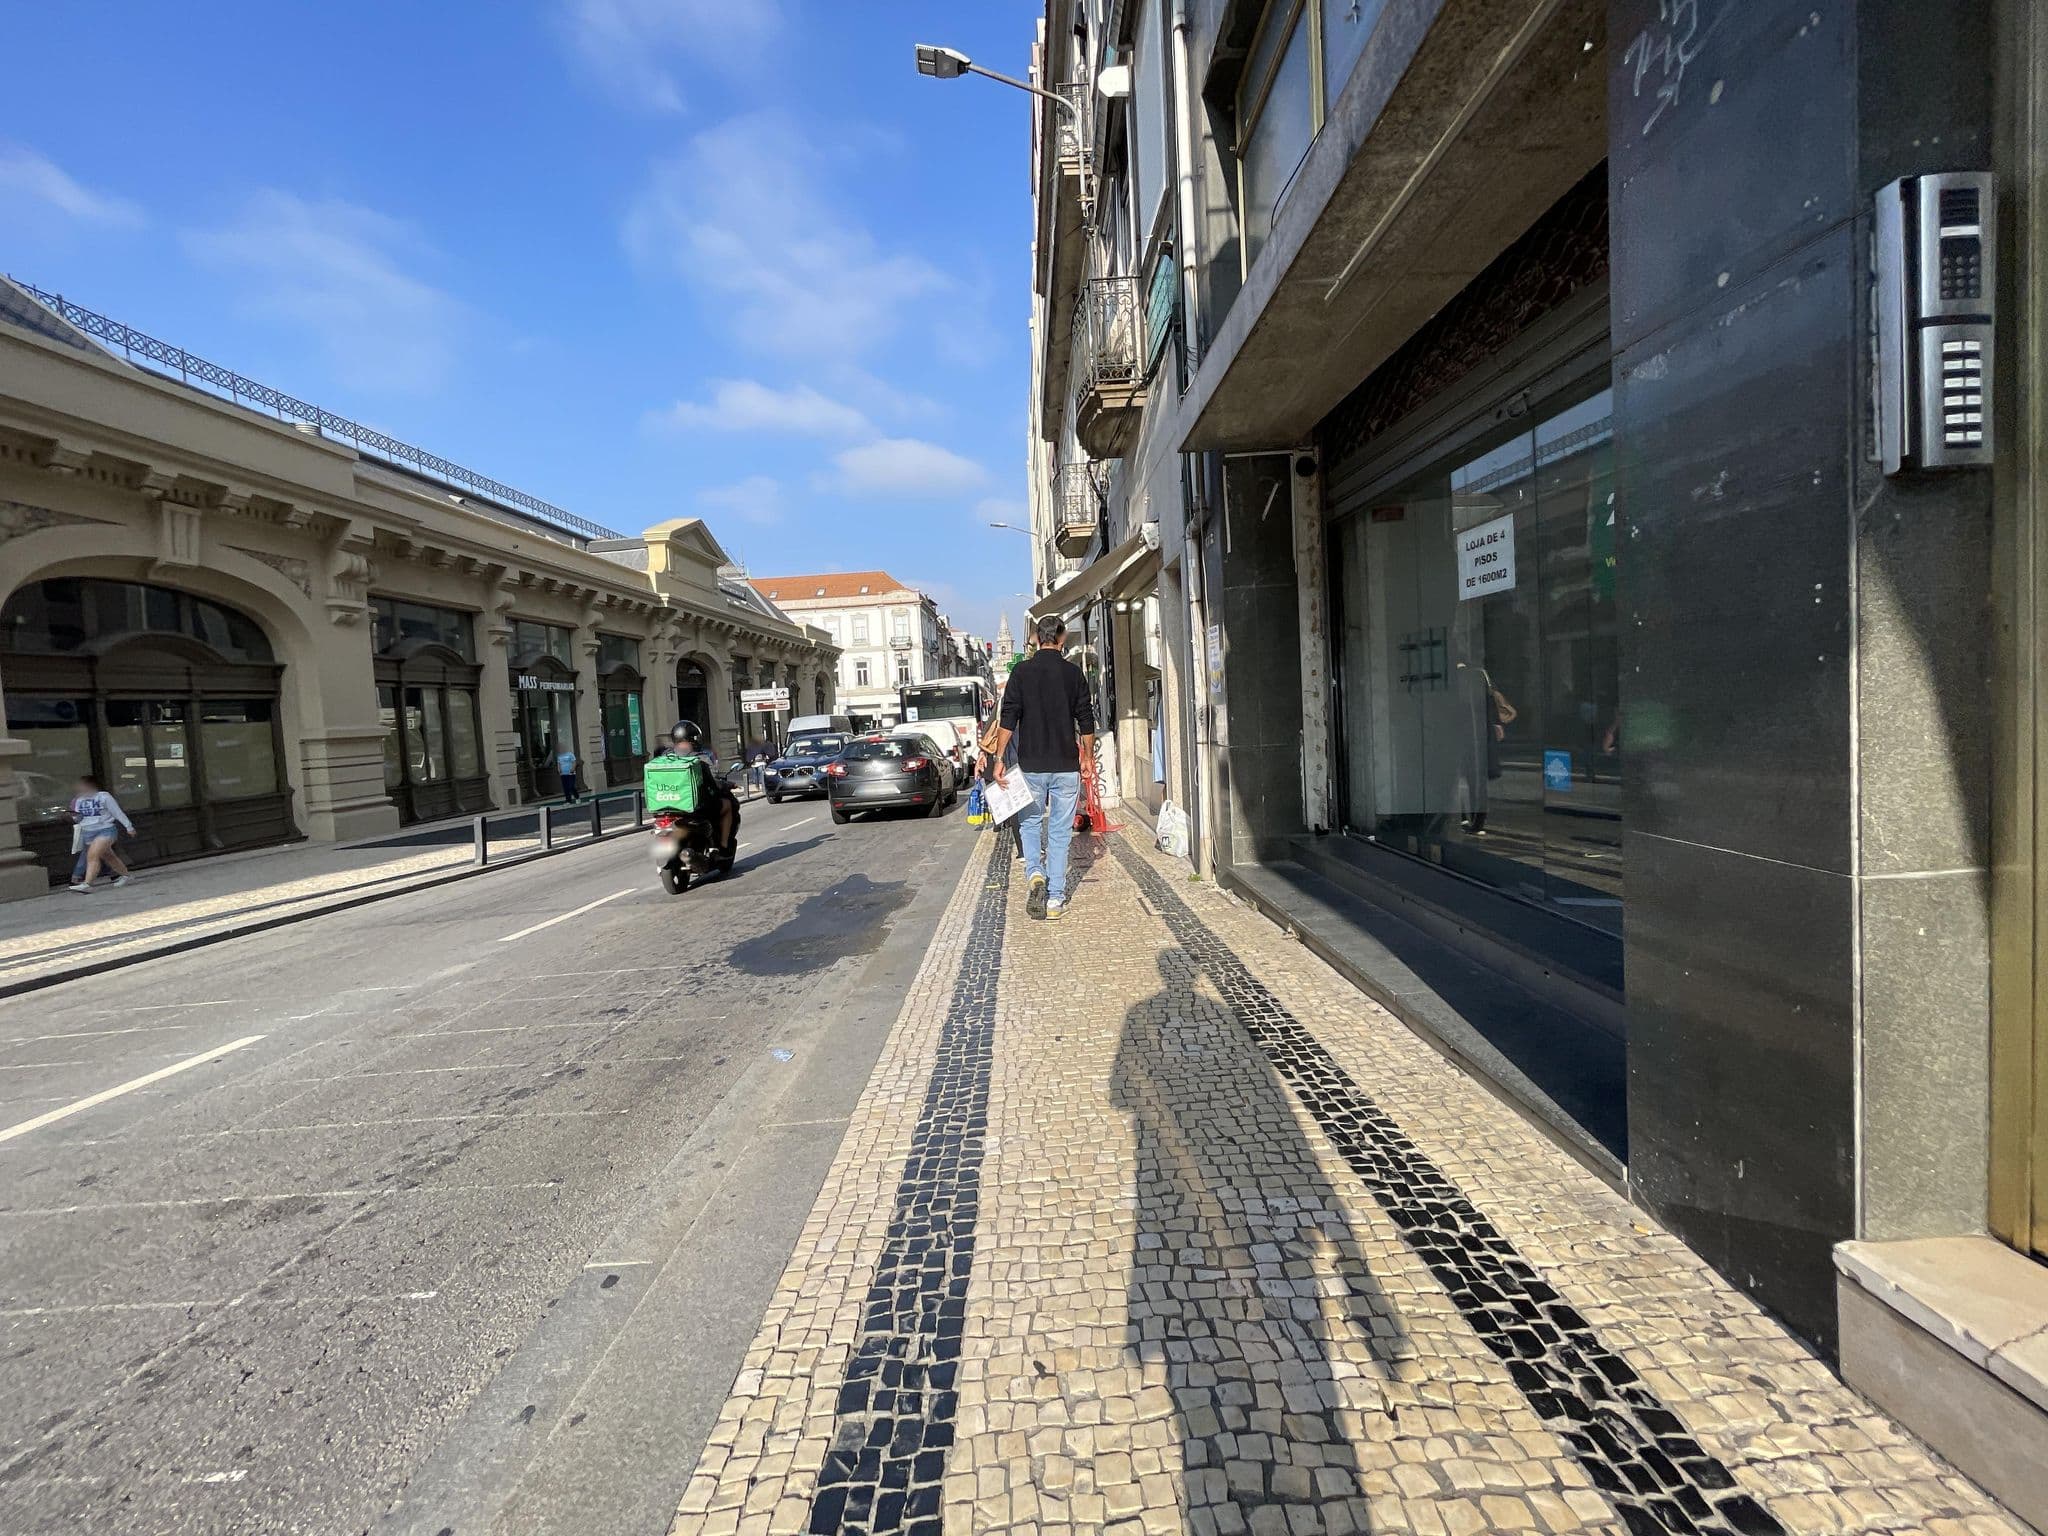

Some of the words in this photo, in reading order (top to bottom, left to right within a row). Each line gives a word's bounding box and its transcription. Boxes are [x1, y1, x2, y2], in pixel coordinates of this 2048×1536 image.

[1465, 537, 1485, 551] LOJA
[1487, 532, 1498, 544] DE
[1500, 530, 1505, 540] 4
[1474, 552, 1498, 567] PISOS
[1466, 577, 1476, 588] DE
[1478, 568, 1507, 584] 1600M2
[518, 675, 537, 689] MASS
[656, 783, 679, 792] Uber
[656, 792, 681, 801] Eats
